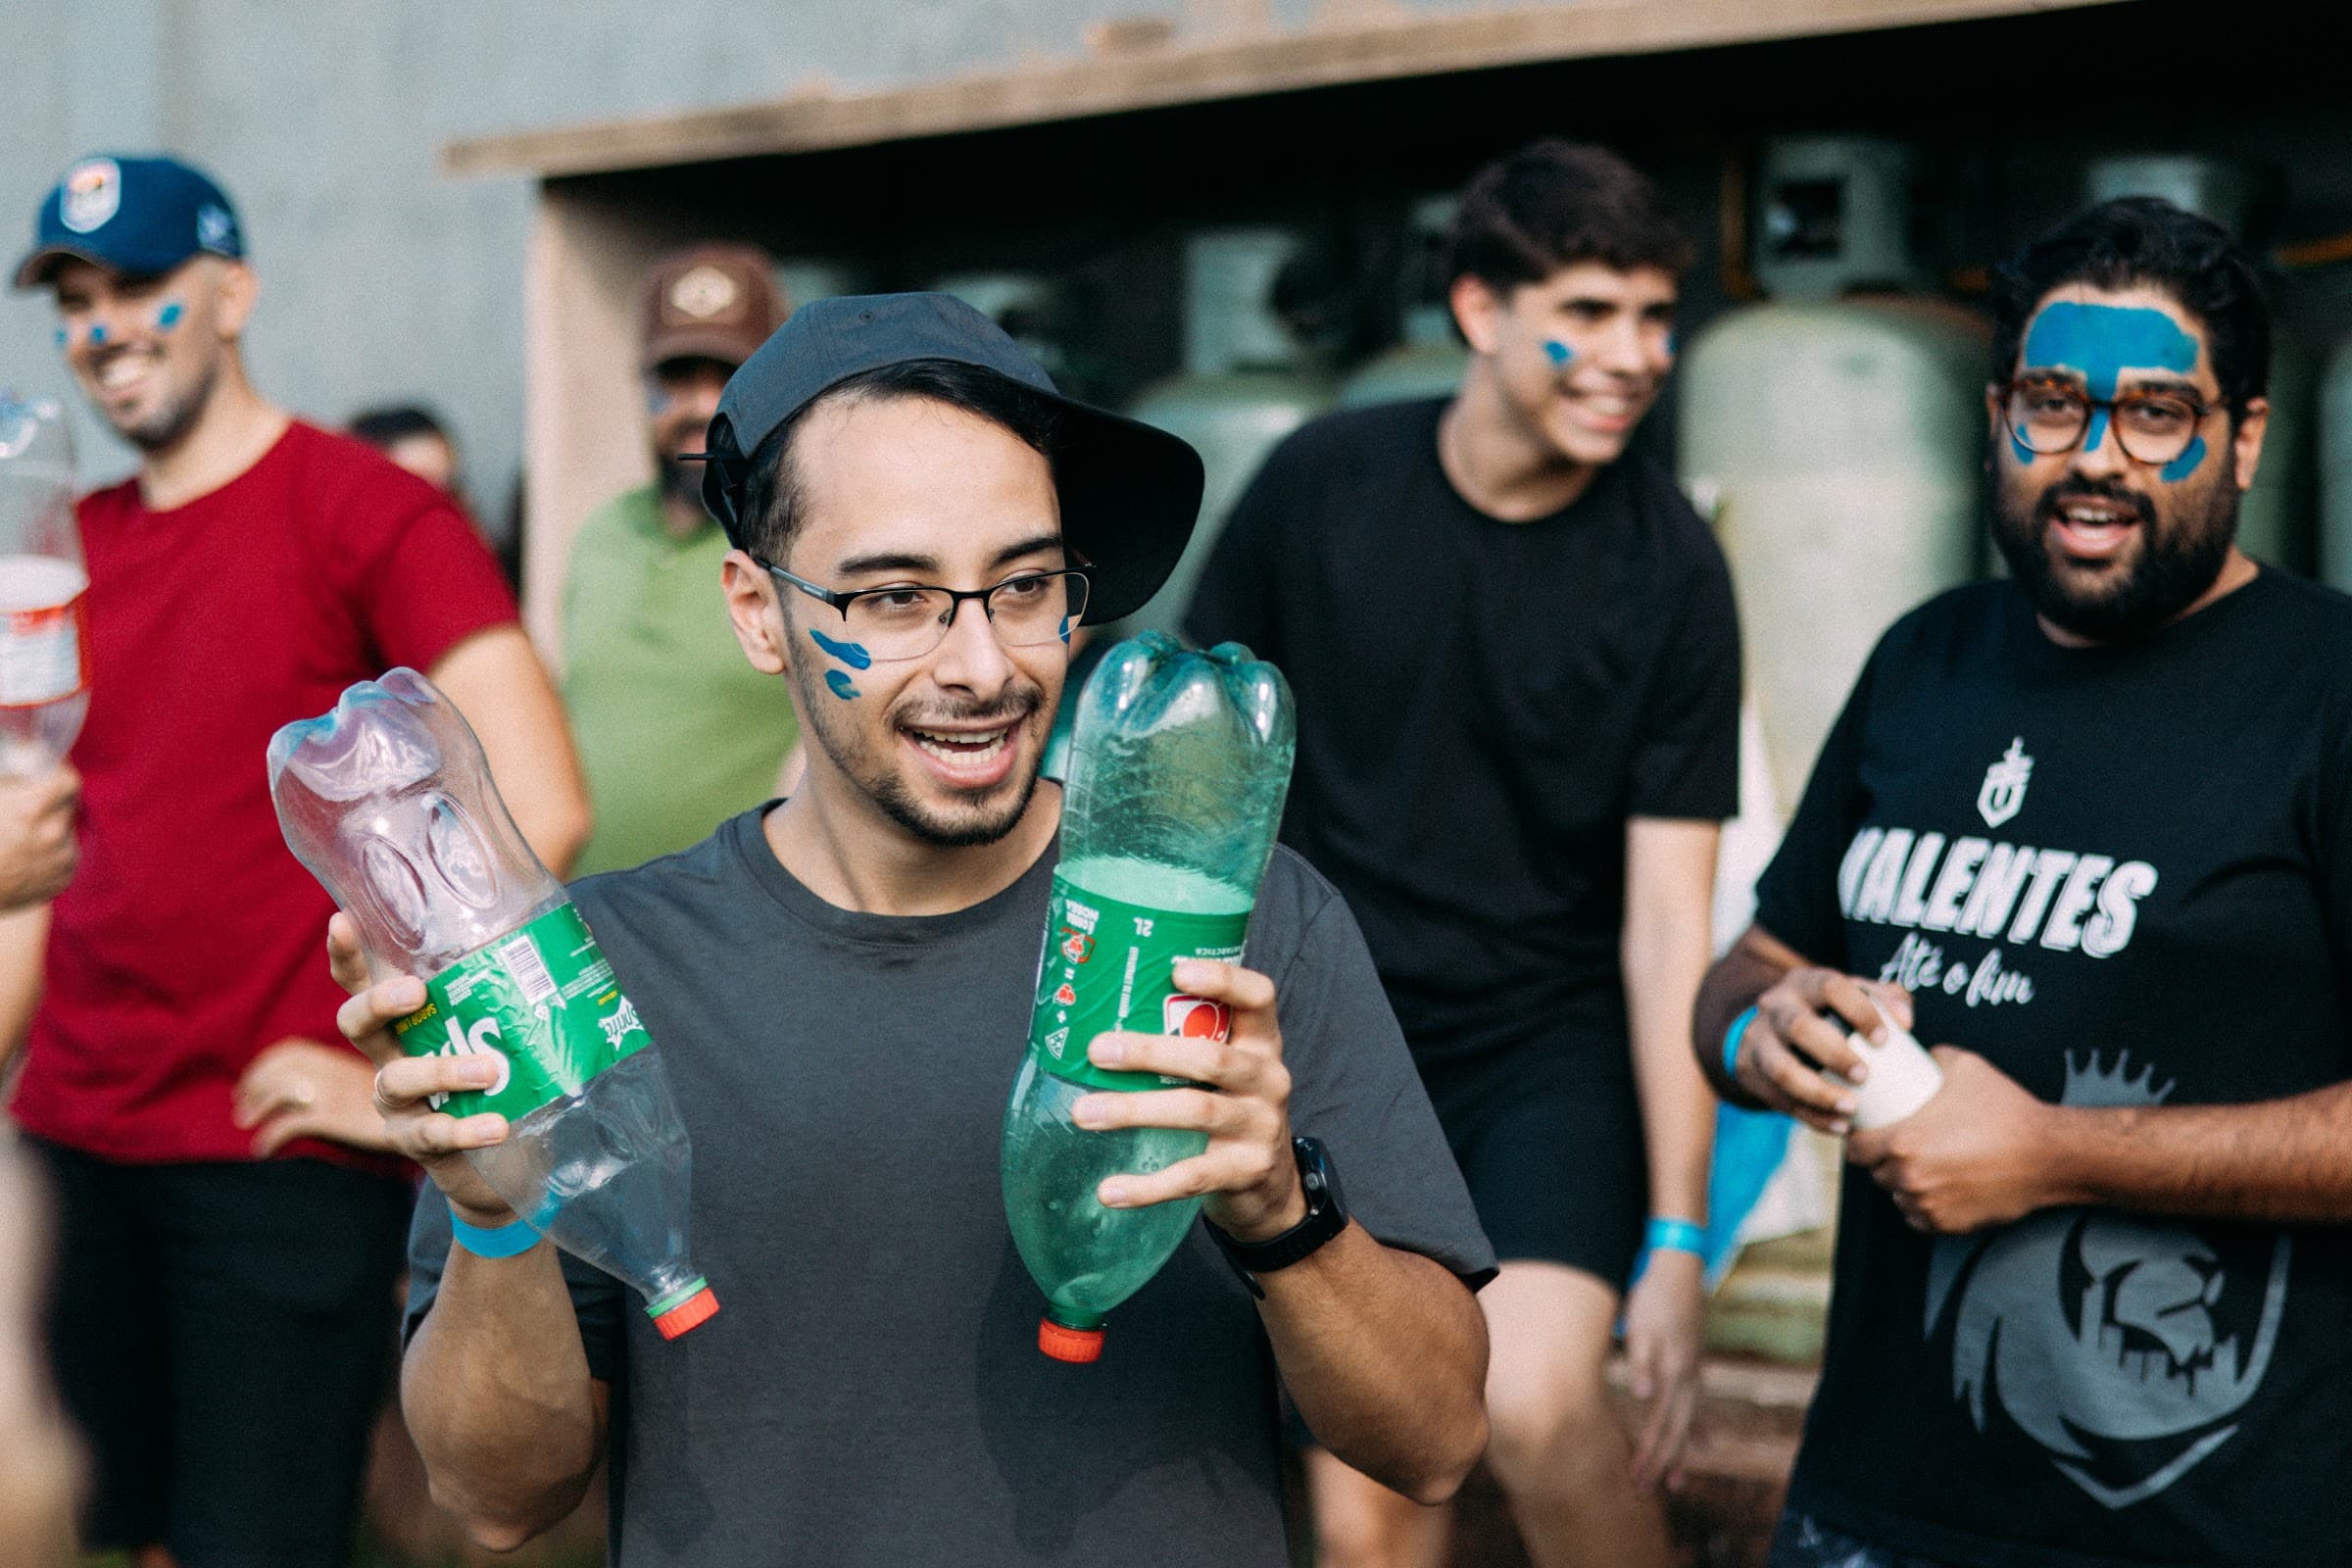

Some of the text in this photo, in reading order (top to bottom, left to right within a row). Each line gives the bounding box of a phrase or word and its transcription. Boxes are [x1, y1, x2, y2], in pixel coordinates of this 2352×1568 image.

[1838, 827, 2159, 958] VALENTES
[1134, 917, 1154, 937] 2L
[1941, 961, 1971, 996] o
[1964, 948, 2035, 1008] fim
[606, 1004, 642, 1040] Sprite
